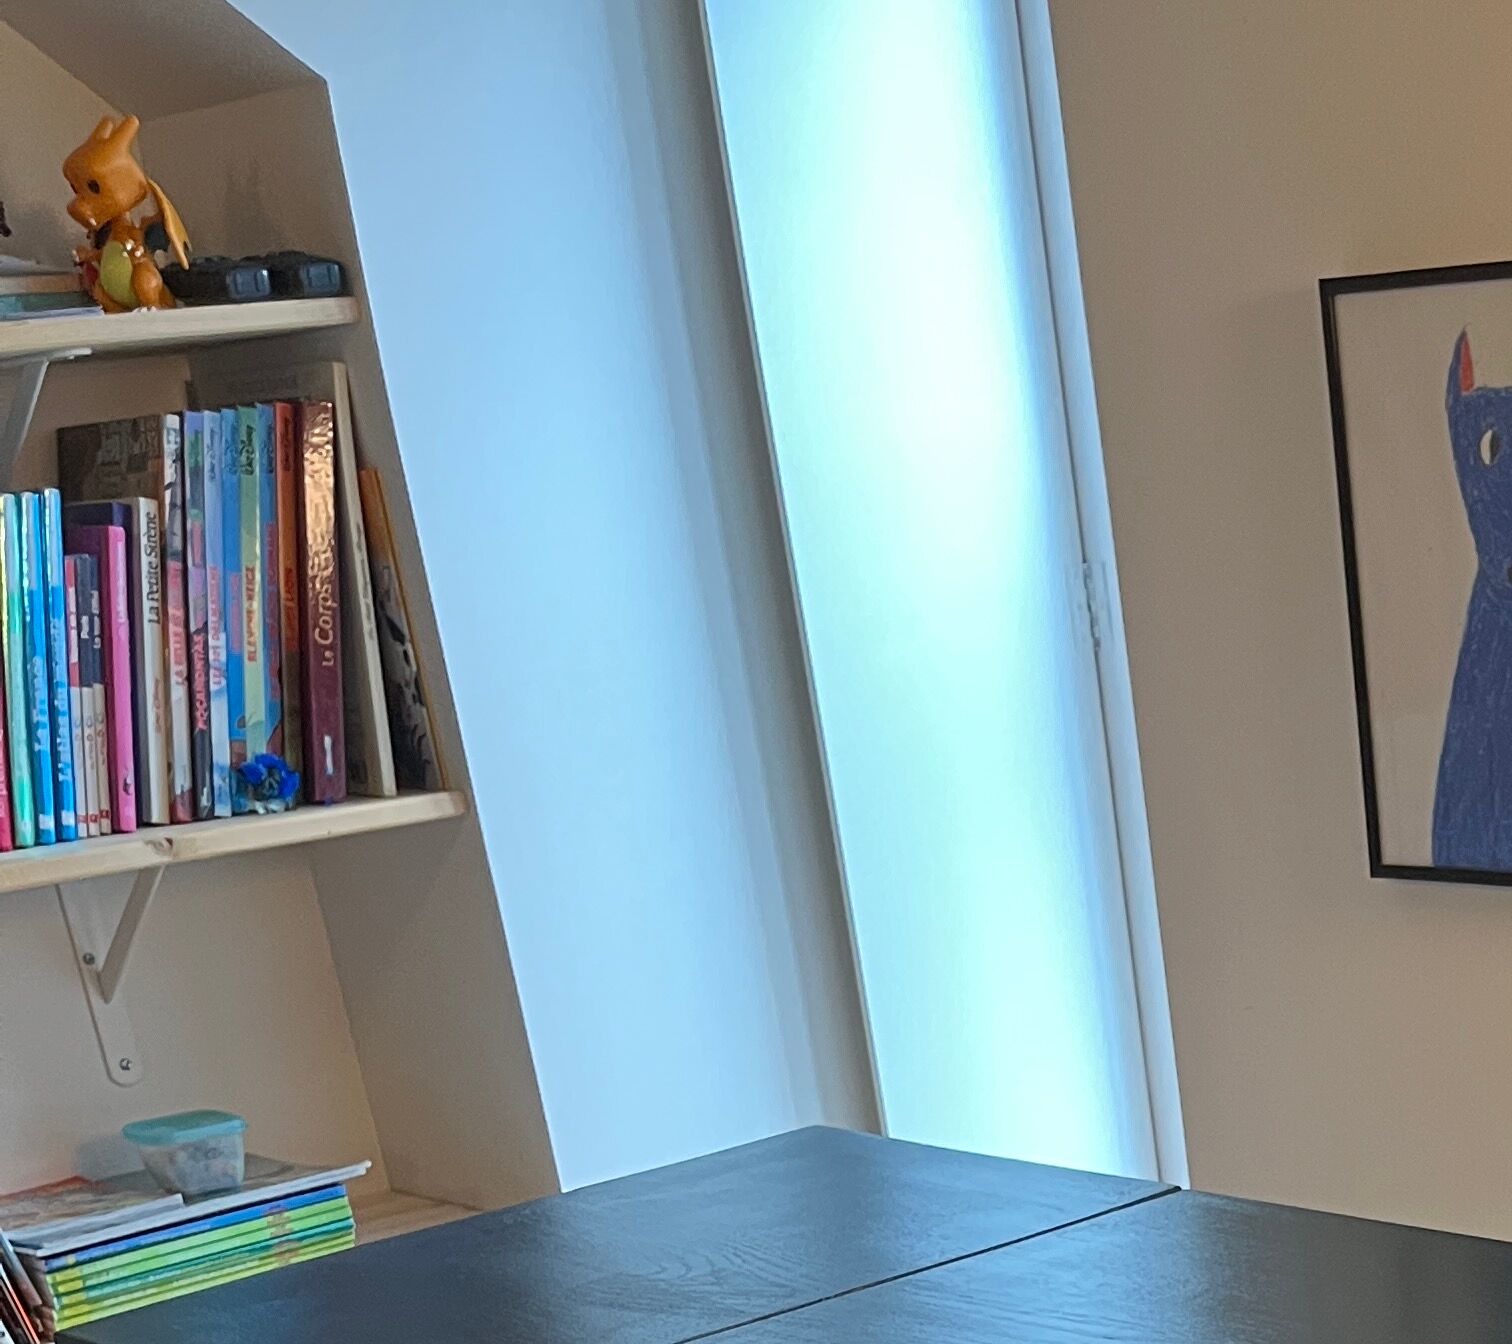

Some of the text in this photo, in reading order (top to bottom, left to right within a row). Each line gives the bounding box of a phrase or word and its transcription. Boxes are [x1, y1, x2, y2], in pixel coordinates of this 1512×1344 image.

[144, 511, 161, 625] La Petite Sirène
[314, 584, 338, 645] Corps
[193, 633, 209, 731] POCAHONTAS
